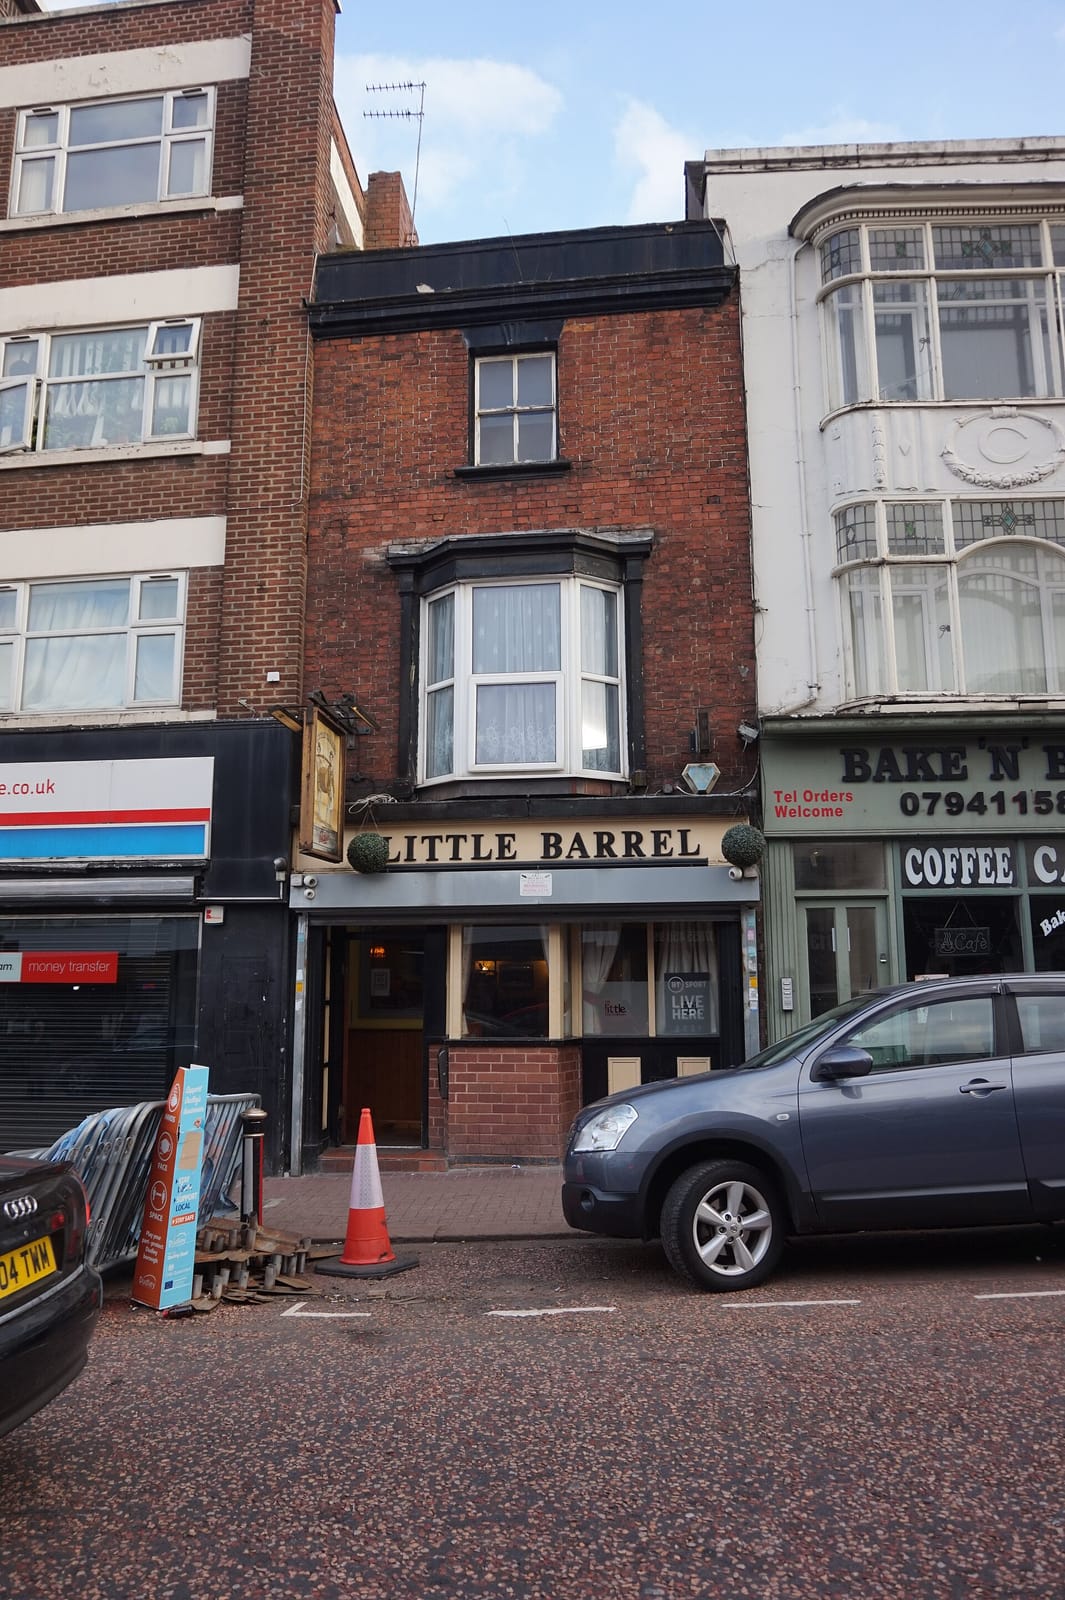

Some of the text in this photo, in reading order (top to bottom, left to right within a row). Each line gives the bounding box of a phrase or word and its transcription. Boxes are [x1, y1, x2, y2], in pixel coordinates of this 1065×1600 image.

[840, 746, 968, 783] BAKE
[774, 789, 853, 803] Tel Orders
[775, 805, 843, 818] Welcome
[387, 829, 700, 863] LITTLE BARREL
[905, 845, 1065, 885] COFFEE C
[28, 960, 65, 974] money
[69, 958, 110, 971] transfer
[685, 981, 707, 989] SPORT
[671, 995, 704, 1009] LIVE
[672, 1008, 704, 1020] HERE
[157, 1162, 168, 1172] FACE
[175, 1202, 191, 1213] LOCAL
[148, 1210, 164, 1222] SPACE
[20, 1241, 50, 1278] TWM
